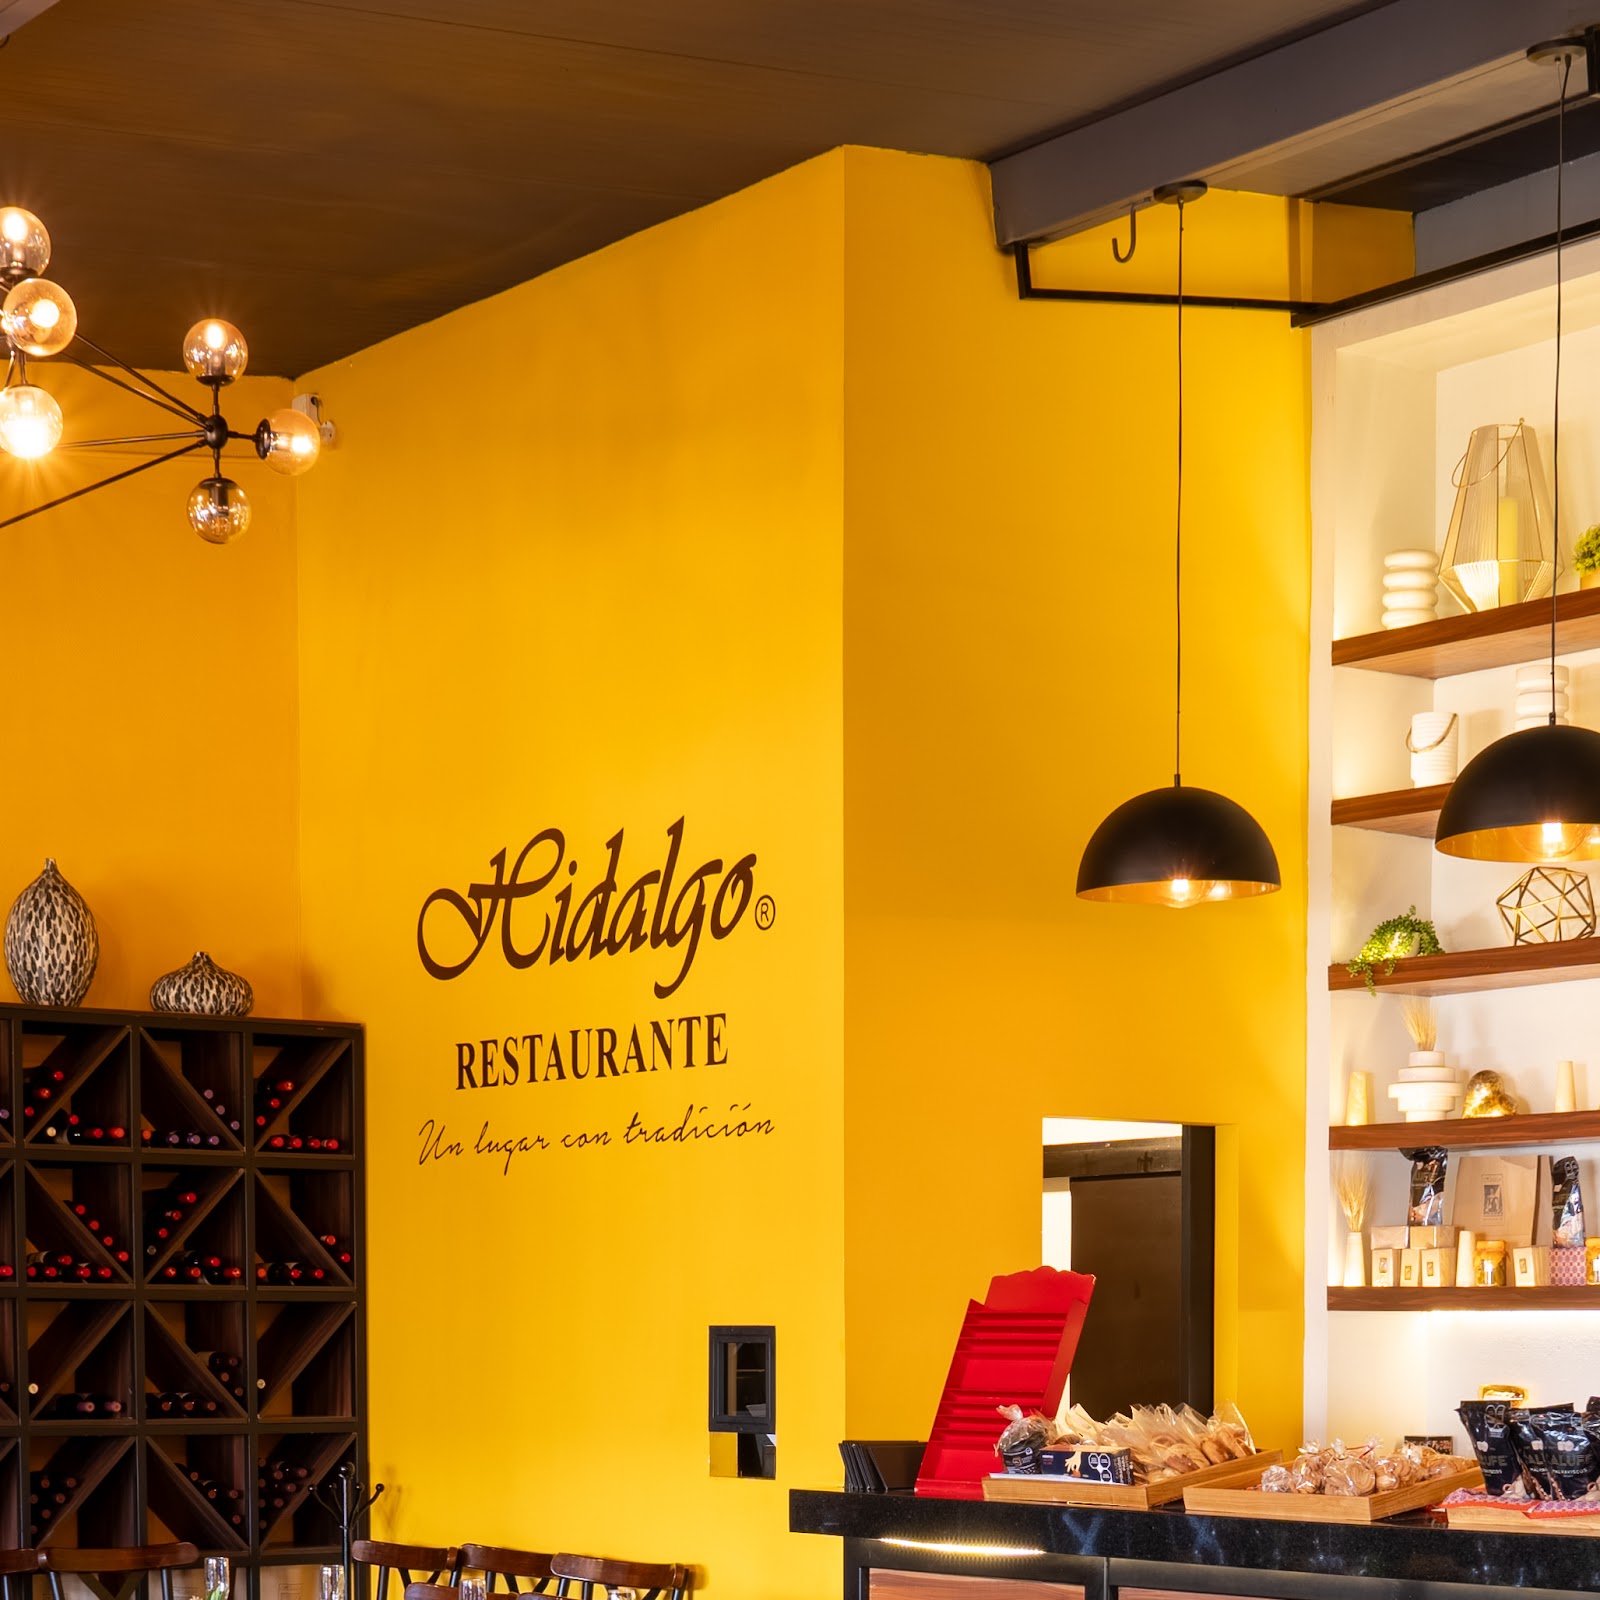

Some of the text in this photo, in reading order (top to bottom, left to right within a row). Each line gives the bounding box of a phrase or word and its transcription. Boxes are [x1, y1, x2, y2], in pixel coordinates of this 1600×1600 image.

[417, 815, 757, 999] Hidalgo
[455, 1013, 729, 1091] RESTAURANTE
[418, 1103, 775, 1176] Un lugar con tradición
